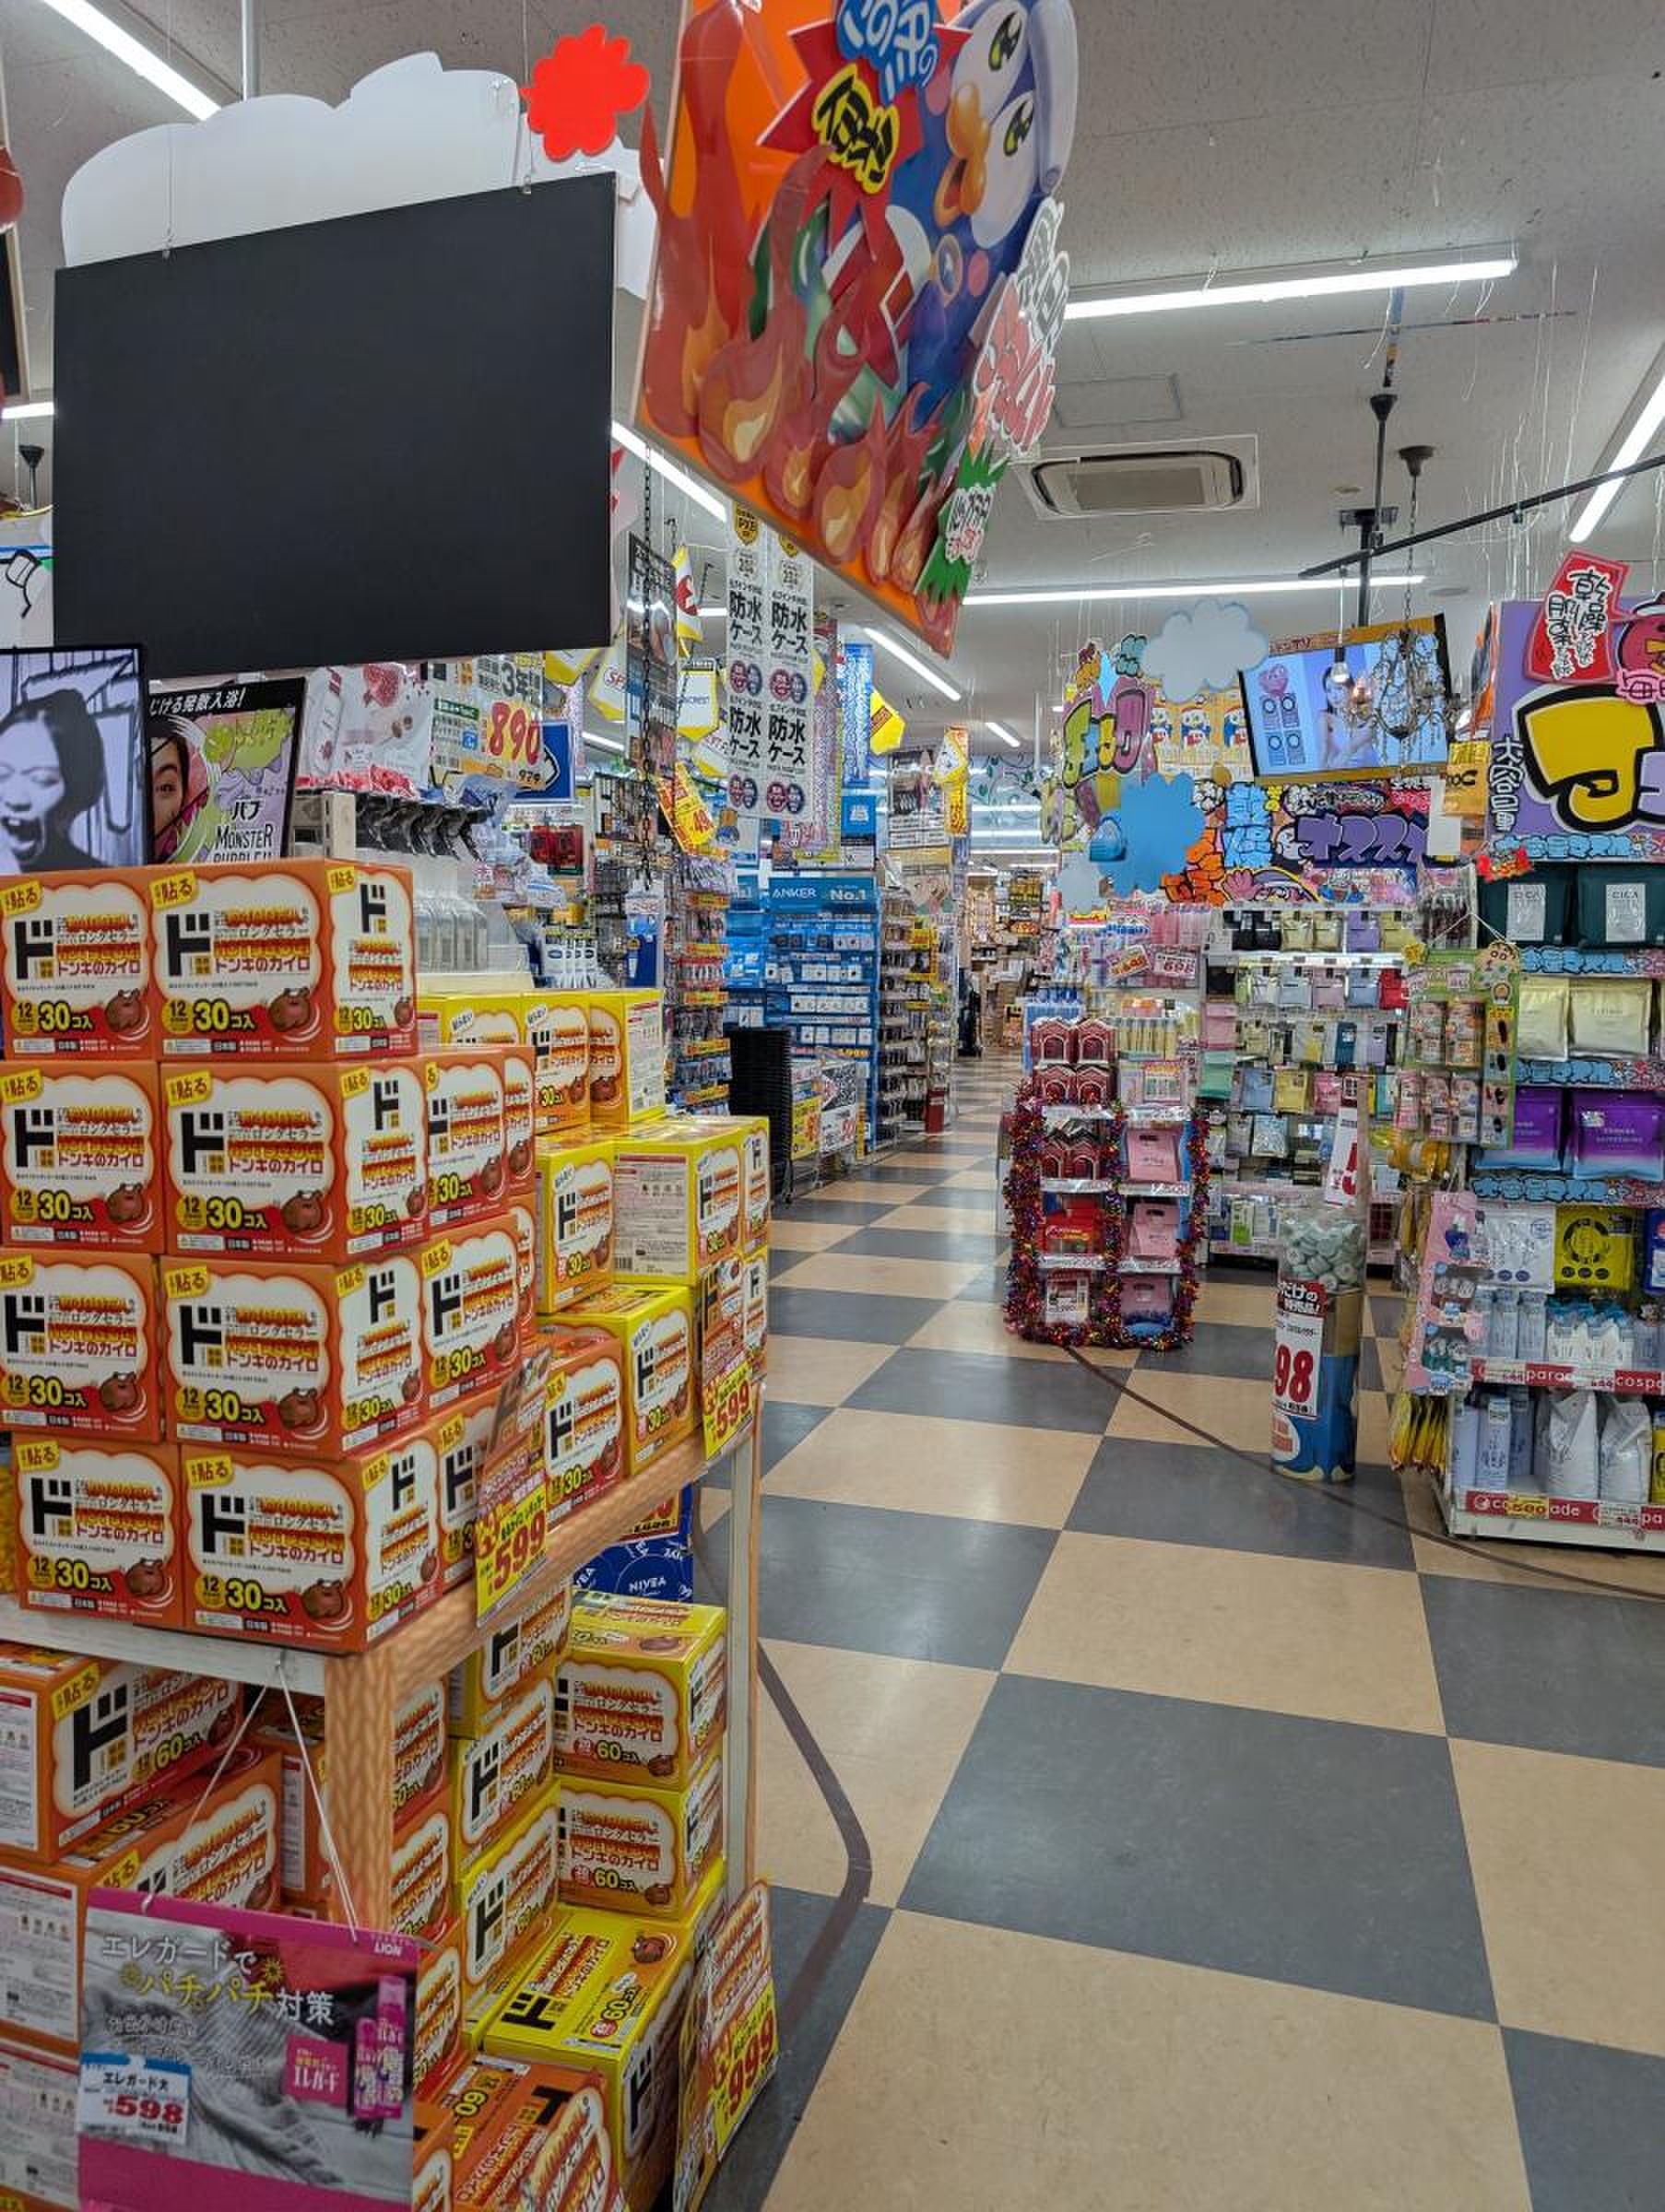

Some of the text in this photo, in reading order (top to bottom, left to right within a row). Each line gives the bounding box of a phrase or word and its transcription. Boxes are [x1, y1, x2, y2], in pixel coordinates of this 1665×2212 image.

[729, 591, 762, 622] 防水
[772, 602, 808, 633] 防水
[730, 619, 762, 645] ケース
[771, 629, 809, 654] ケース
[489, 701, 540, 766] 890
[729, 706, 762, 737] 防水
[768, 714, 806, 745] 防水
[729, 735, 761, 759] ケース
[768, 742, 806, 766] ケース
[215, 823, 275, 850] MONSTER
[360, 884, 385, 933] ド
[772, 887, 867, 900] ANKER No.1
[14, 919, 54, 980] ド
[166, 913, 210, 977] ド
[58, 959, 141, 976] ドンキのカイロ
[215, 957, 311, 973] ドンキのカイロ
[18, 1002, 32, 1018] 12
[39, 1000, 93, 1032] 30コ入
[170, 1000, 186, 1016] 12
[195, 998, 255, 1032] 30コ入
[373, 1080, 399, 1131] ド
[14, 1109, 54, 1168] ド
[181, 1112, 224, 1174] ド
[57, 1152, 144, 1167] ドンキのカイロ
[229, 1159, 324, 1175] ドンキのカイロ
[17, 1190, 32, 1206] 12
[38, 1189, 93, 1221] 30コ入
[183, 1196, 199, 1213] 12
[207, 1195, 267, 1230] 30コ入
[559, 1192, 575, 1240] ド
[369, 1271, 395, 1324] ド
[431, 1274, 461, 1336] ド
[5, 1295, 44, 1353] ド
[180, 1305, 222, 1365] ド
[49, 1342, 136, 1358] ドンキのカイロ
[227, 1355, 319, 1372] ドンキのカイロ
[7, 1374, 23, 1391] 12
[637, 1347, 654, 1398] ド
[1275, 1343, 1314, 1404] 98
[30, 1374, 88, 1407] 30コ入
[183, 1388, 199, 1404] 12
[206, 1389, 266, 1425] 30コ入
[716, 1382, 750, 1440] 599
[549, 1401, 573, 1461] ド
[392, 1455, 414, 1511] ド
[30, 1477, 72, 1534] ド
[77, 1524, 163, 1544] ドンキのカイロ
[201, 1494, 244, 1553] ド
[33, 1557, 49, 1573] 12
[250, 1542, 344, 1565] ドンキのカイロ
[492, 1508, 546, 1593] 599
[55, 1558, 112, 1592] 30コ入
[202, 1575, 219, 1591] 12
[629, 1576, 667, 1593] NIVEA
[226, 1578, 288, 1614] 30コ入
[73, 1684, 128, 1792] ド
[573, 1720, 663, 1743] ドンキのカイロ
[596, 1740, 642, 1765] 60コ入
[571, 1848, 660, 1872] ドンキのカイロ
[593, 1866, 636, 1893] 60コ入
[102, 1936, 256, 1975] エレガードで
[374, 1941, 403, 1957] LION
[114, 2094, 183, 2125] 598
